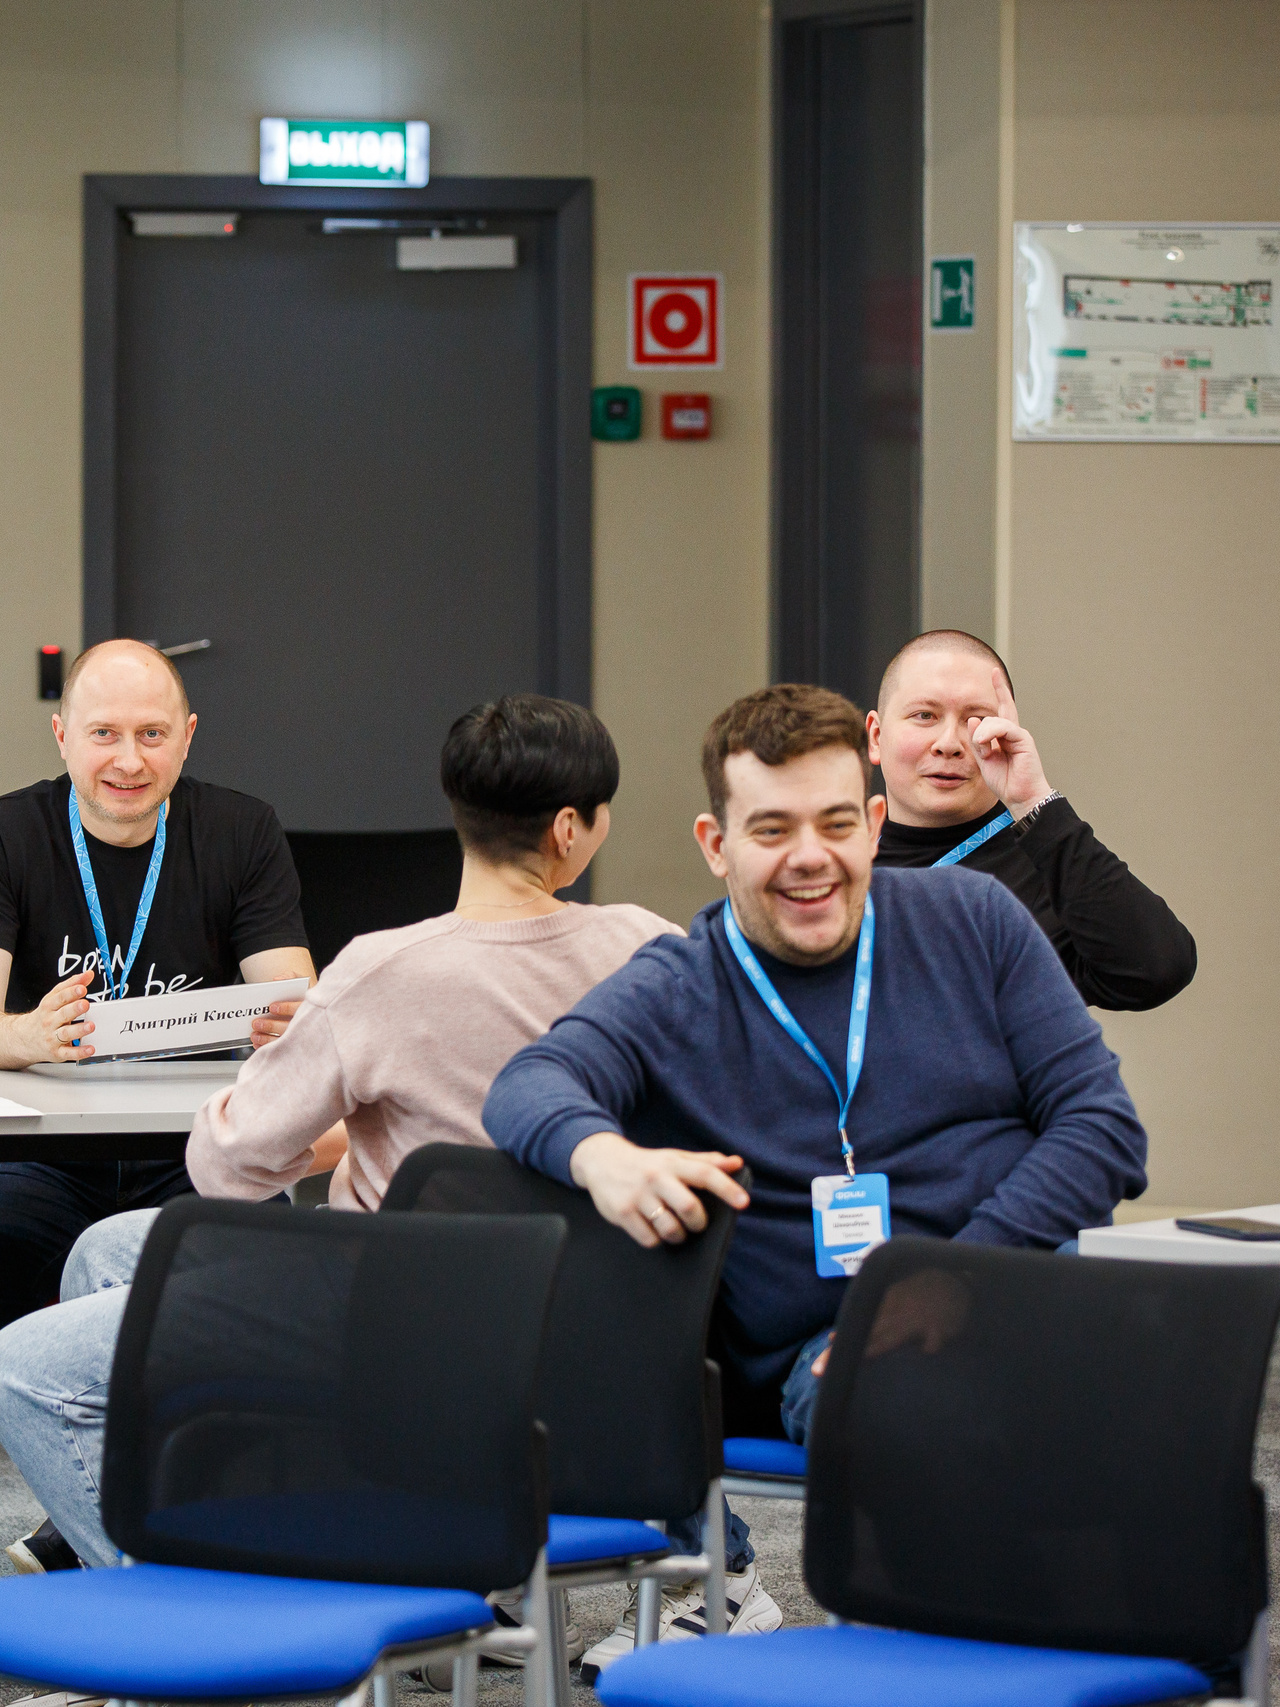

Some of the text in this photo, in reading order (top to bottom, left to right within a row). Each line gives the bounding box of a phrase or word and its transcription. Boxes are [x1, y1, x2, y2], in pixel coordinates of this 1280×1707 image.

[288, 130, 405, 174] ВЫХОД
[119, 1005, 270, 1034] Дмитрий Киселев
